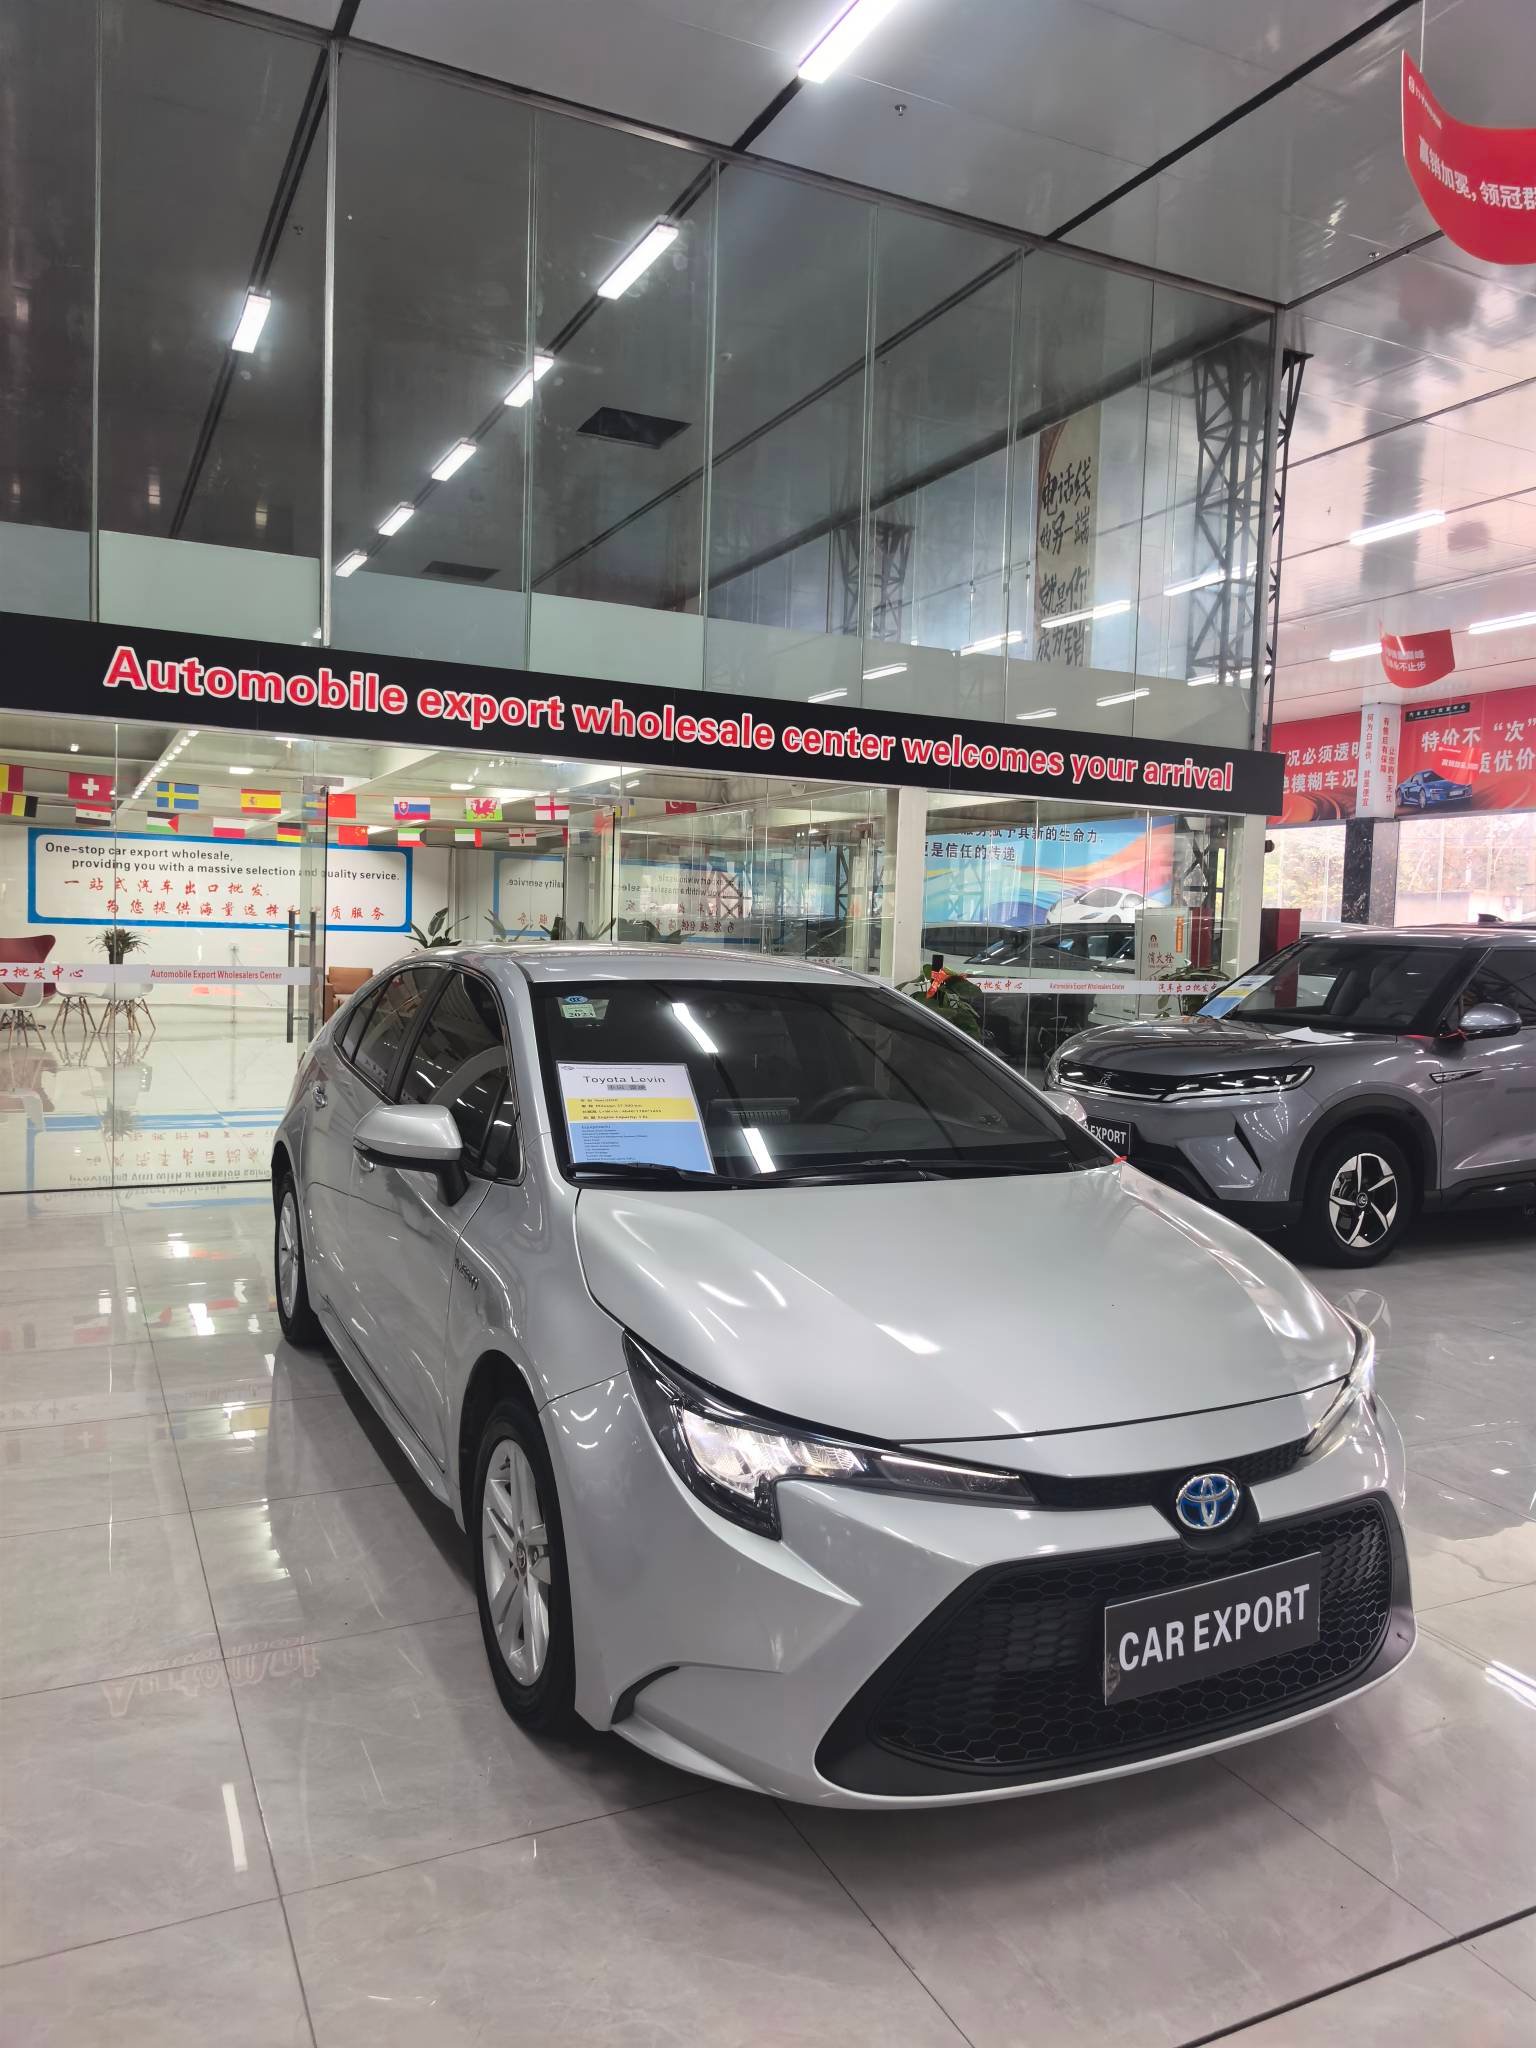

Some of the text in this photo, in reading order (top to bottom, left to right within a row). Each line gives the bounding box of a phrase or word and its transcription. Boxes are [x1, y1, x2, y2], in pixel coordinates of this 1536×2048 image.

[103, 645, 1234, 792] Automobile export wholesale center welcomes your arrival
[45, 842, 233, 861] One-stop car export wholesale,
[72, 859, 130, 871] providing
[134, 863, 155, 872] you
[158, 861, 185, 872] with
[197, 864, 243, 875] massive
[245, 865, 296, 877] selection
[298, 867, 318, 877] and
[359, 871, 400, 881] service.
[151, 969, 282, 980] Automobile Export Wholesalers Center
[583, 1075, 666, 1085] Toyota Levin
[1090, 1125, 1127, 1145] EXPORT
[1118, 1584, 1310, 1671] CAR EXPORT
